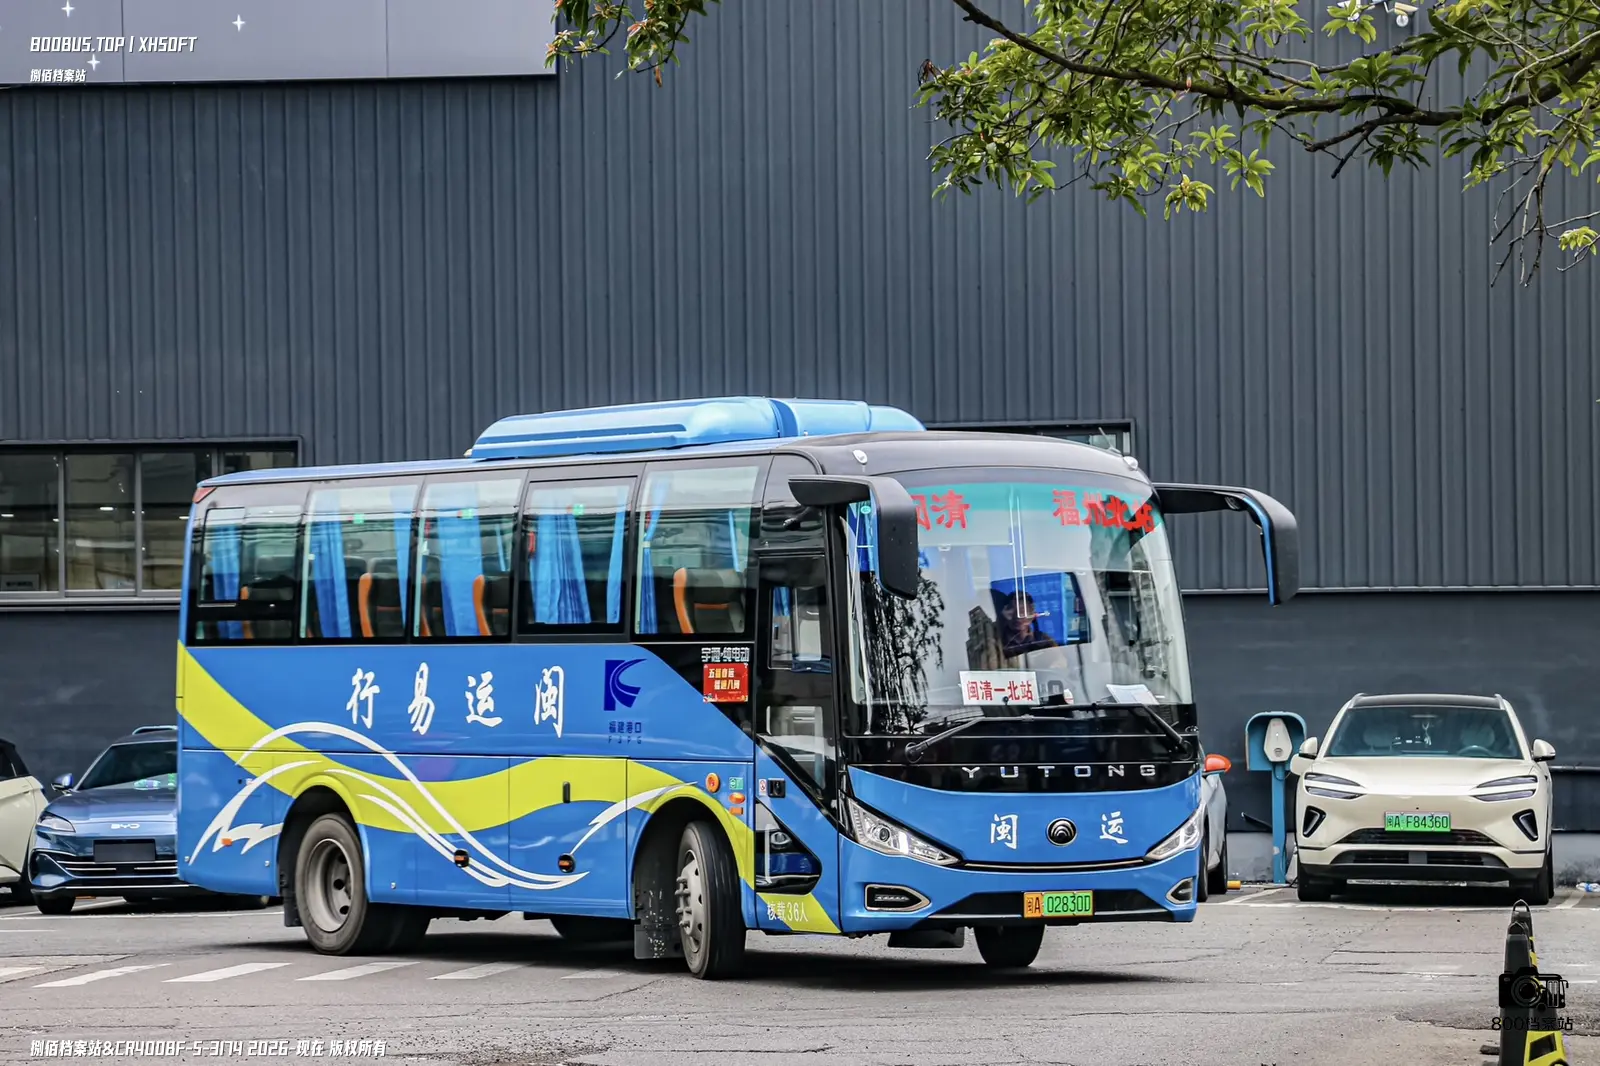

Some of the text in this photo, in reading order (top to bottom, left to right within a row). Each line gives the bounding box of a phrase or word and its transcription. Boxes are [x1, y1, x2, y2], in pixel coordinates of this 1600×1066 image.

[1052, 490, 1155, 533] 福州北站
[961, 765, 1156, 778] YUTONG
[767, 901, 809, 922] 核载36人
